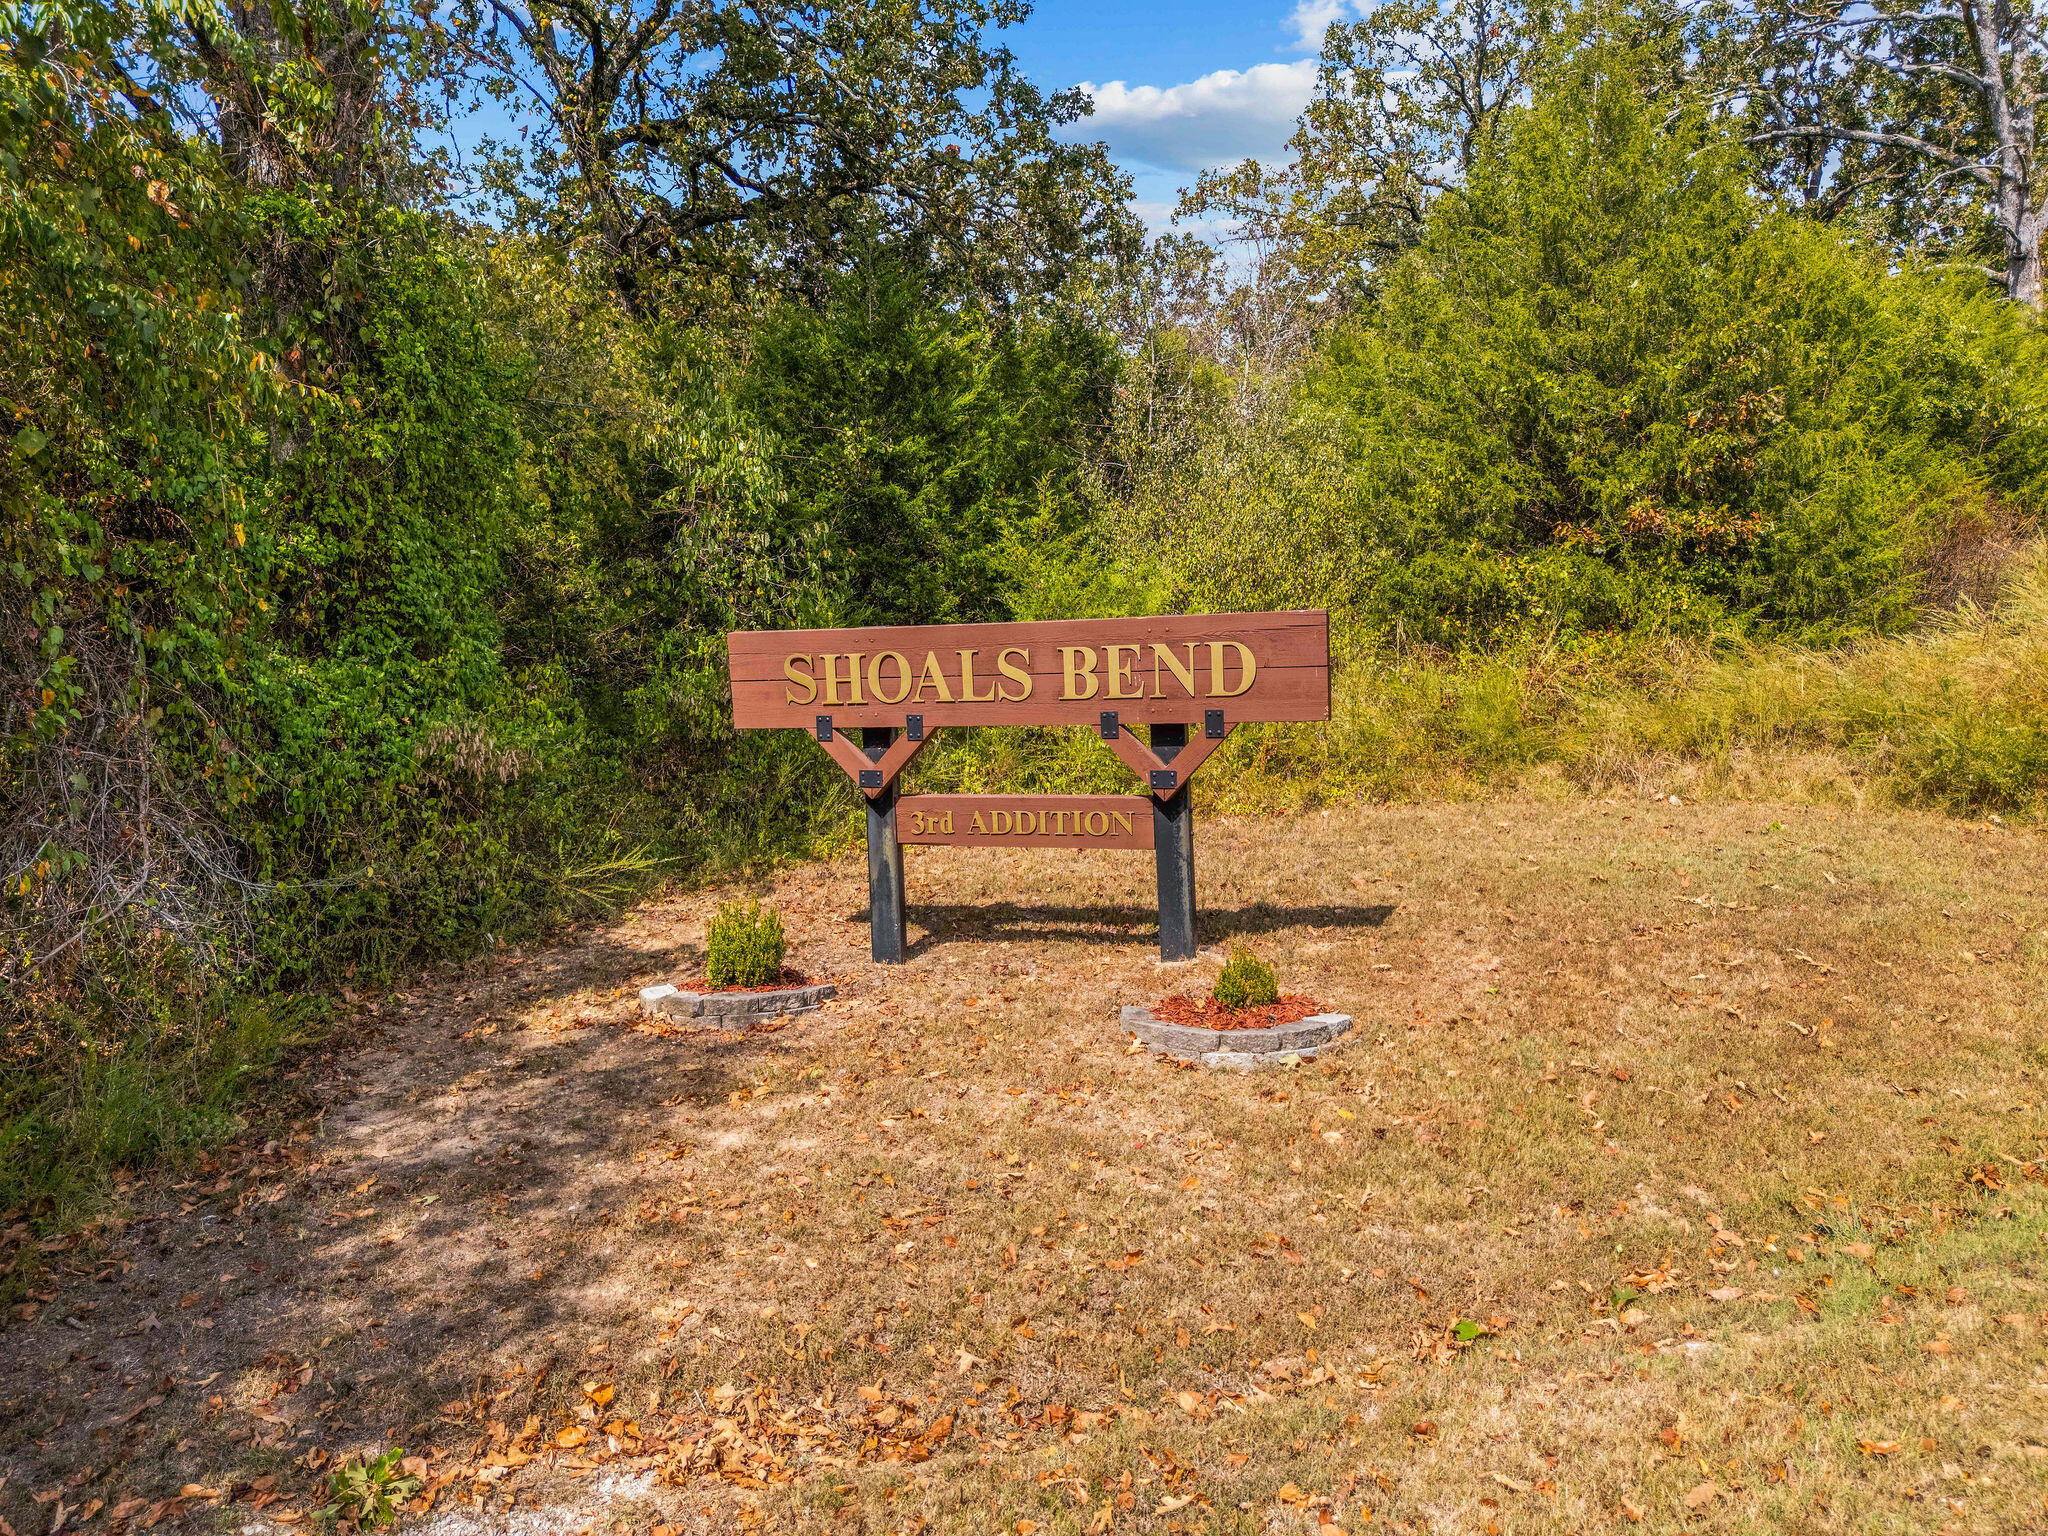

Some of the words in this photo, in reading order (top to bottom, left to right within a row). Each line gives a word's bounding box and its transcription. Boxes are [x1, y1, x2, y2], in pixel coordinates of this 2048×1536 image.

[783, 648, 1033, 706] SHOALS
[1058, 641, 1257, 701] BEND
[910, 810, 955, 836] 3rd
[967, 810, 1134, 837] ADDITION
